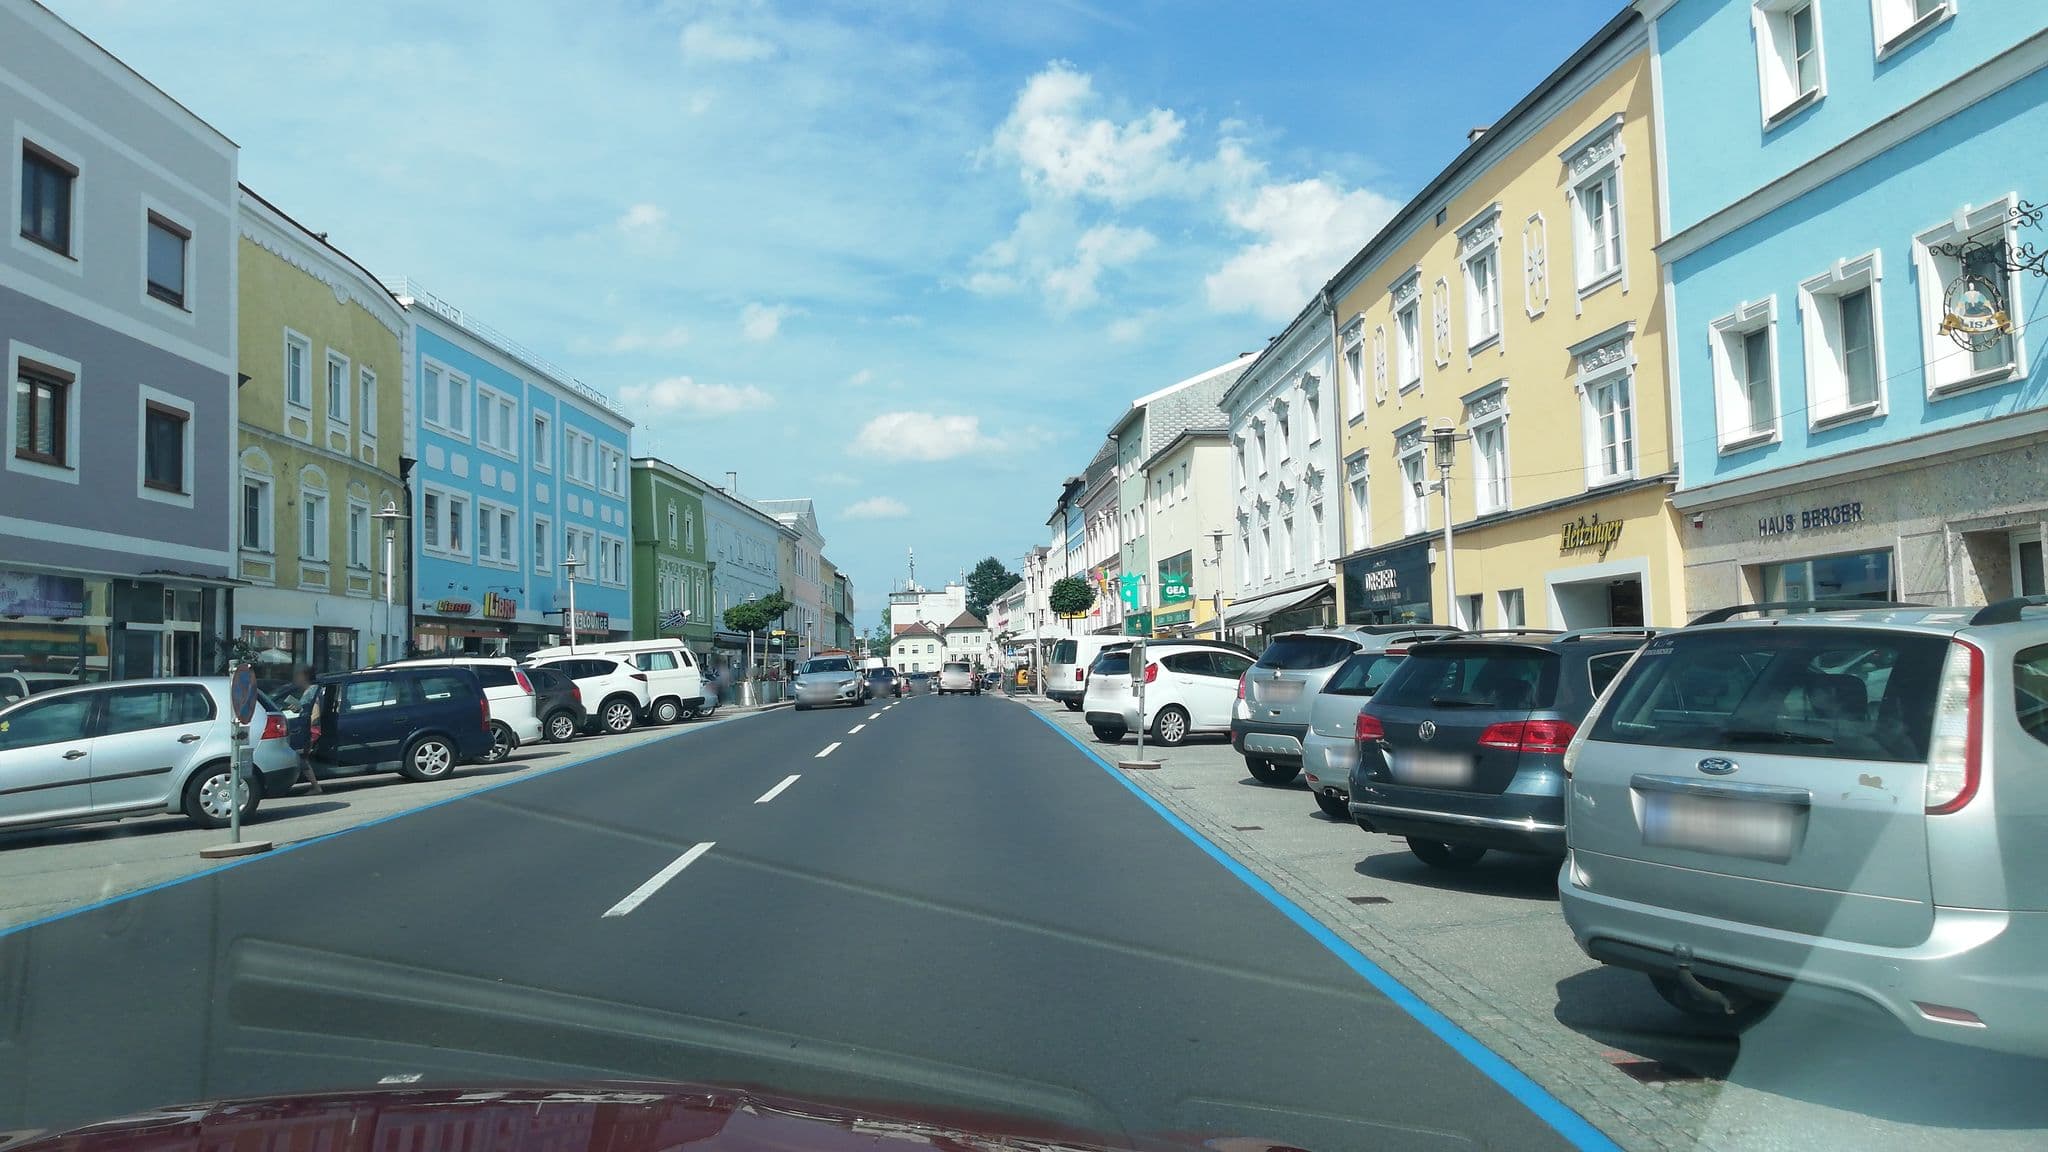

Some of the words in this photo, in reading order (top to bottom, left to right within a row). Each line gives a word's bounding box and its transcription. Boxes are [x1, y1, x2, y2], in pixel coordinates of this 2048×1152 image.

[1759, 514, 1795, 537] HAUS
[1801, 502, 1864, 529] BERGER
[1560, 513, 1624, 556] Heitzinger
[1165, 585, 1187, 595] GEA
[565, 612, 583, 629] BKE
[583, 615, 608, 630] LOUNGE
